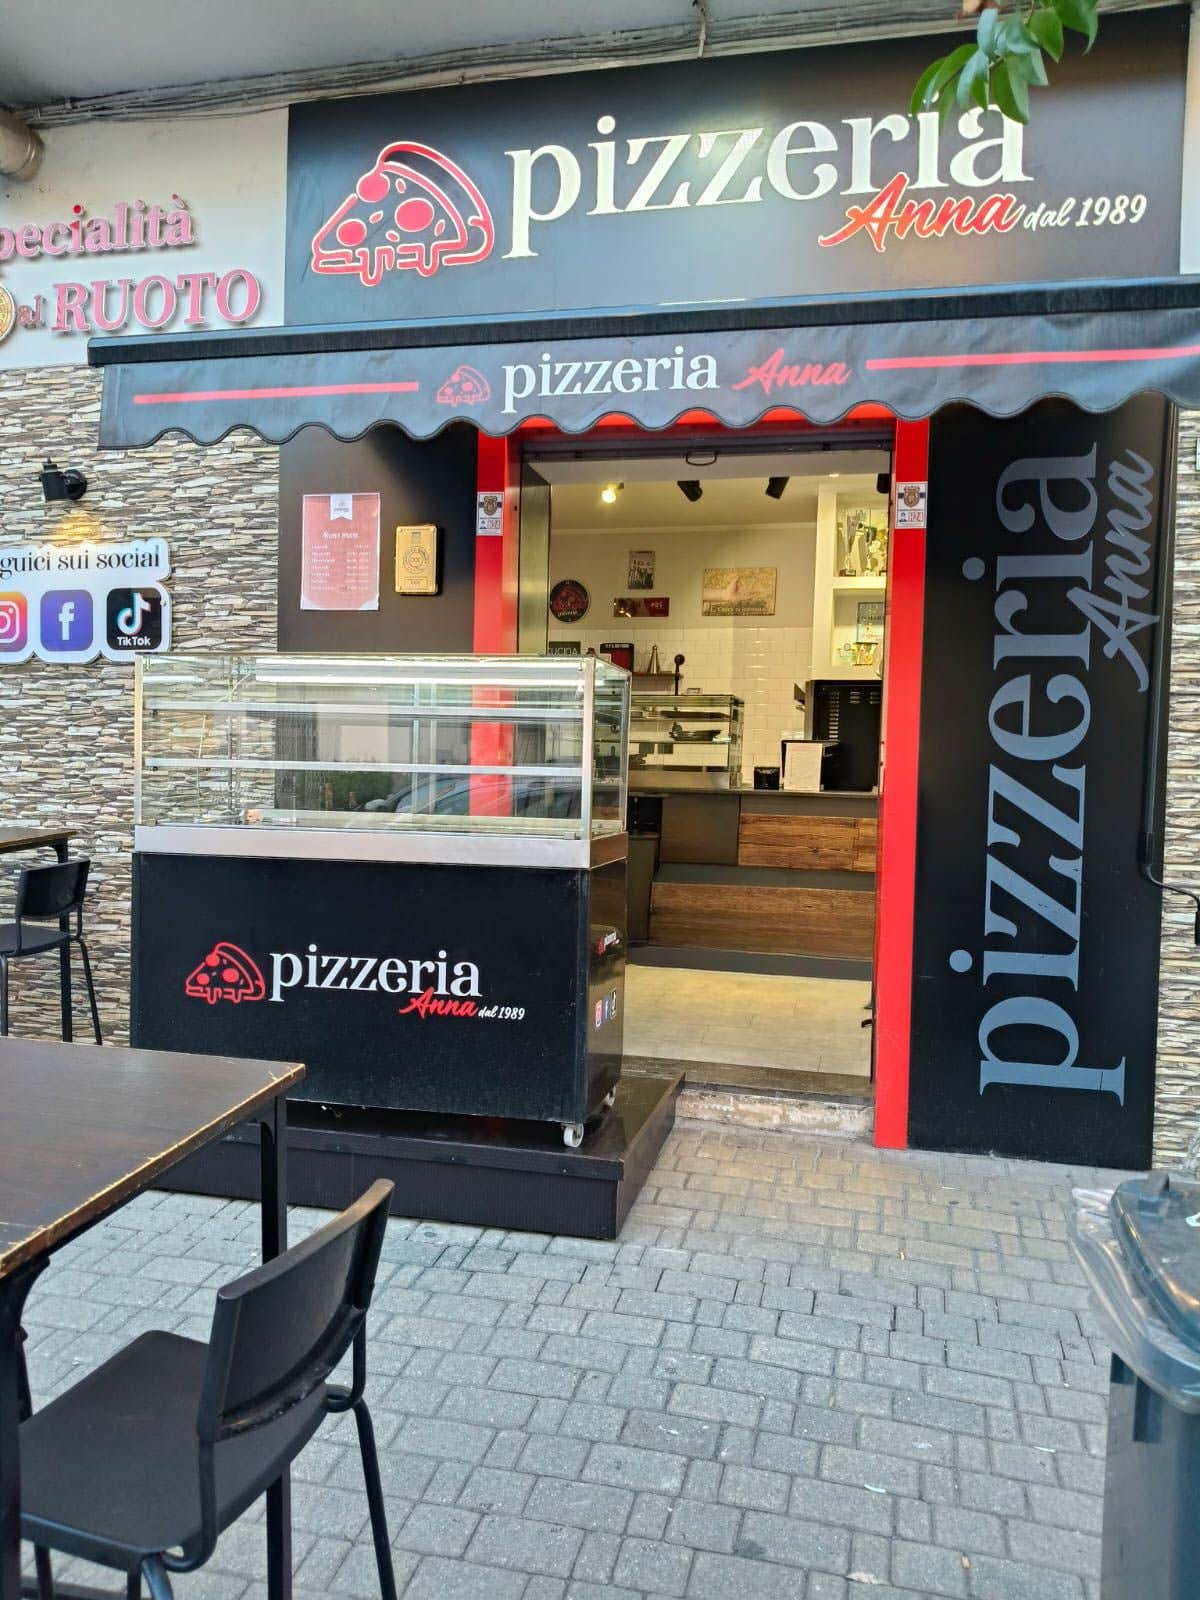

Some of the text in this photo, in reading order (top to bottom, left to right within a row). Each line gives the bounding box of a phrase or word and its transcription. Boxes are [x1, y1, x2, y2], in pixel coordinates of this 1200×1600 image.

[818, 171, 1147, 252] Anna dal 1989
[52, 269, 261, 332] RUOTO
[501, 346, 852, 413] pizzeria Anna
[0, 544, 160, 581] guici sui social
[1065, 449, 1160, 693] Anna
[117, 636, 151, 647] TikTok
[948, 441, 1126, 1107] pizzeria
[268, 943, 483, 1003] pizzeria
[399, 986, 525, 1020] Anna dal 1989
